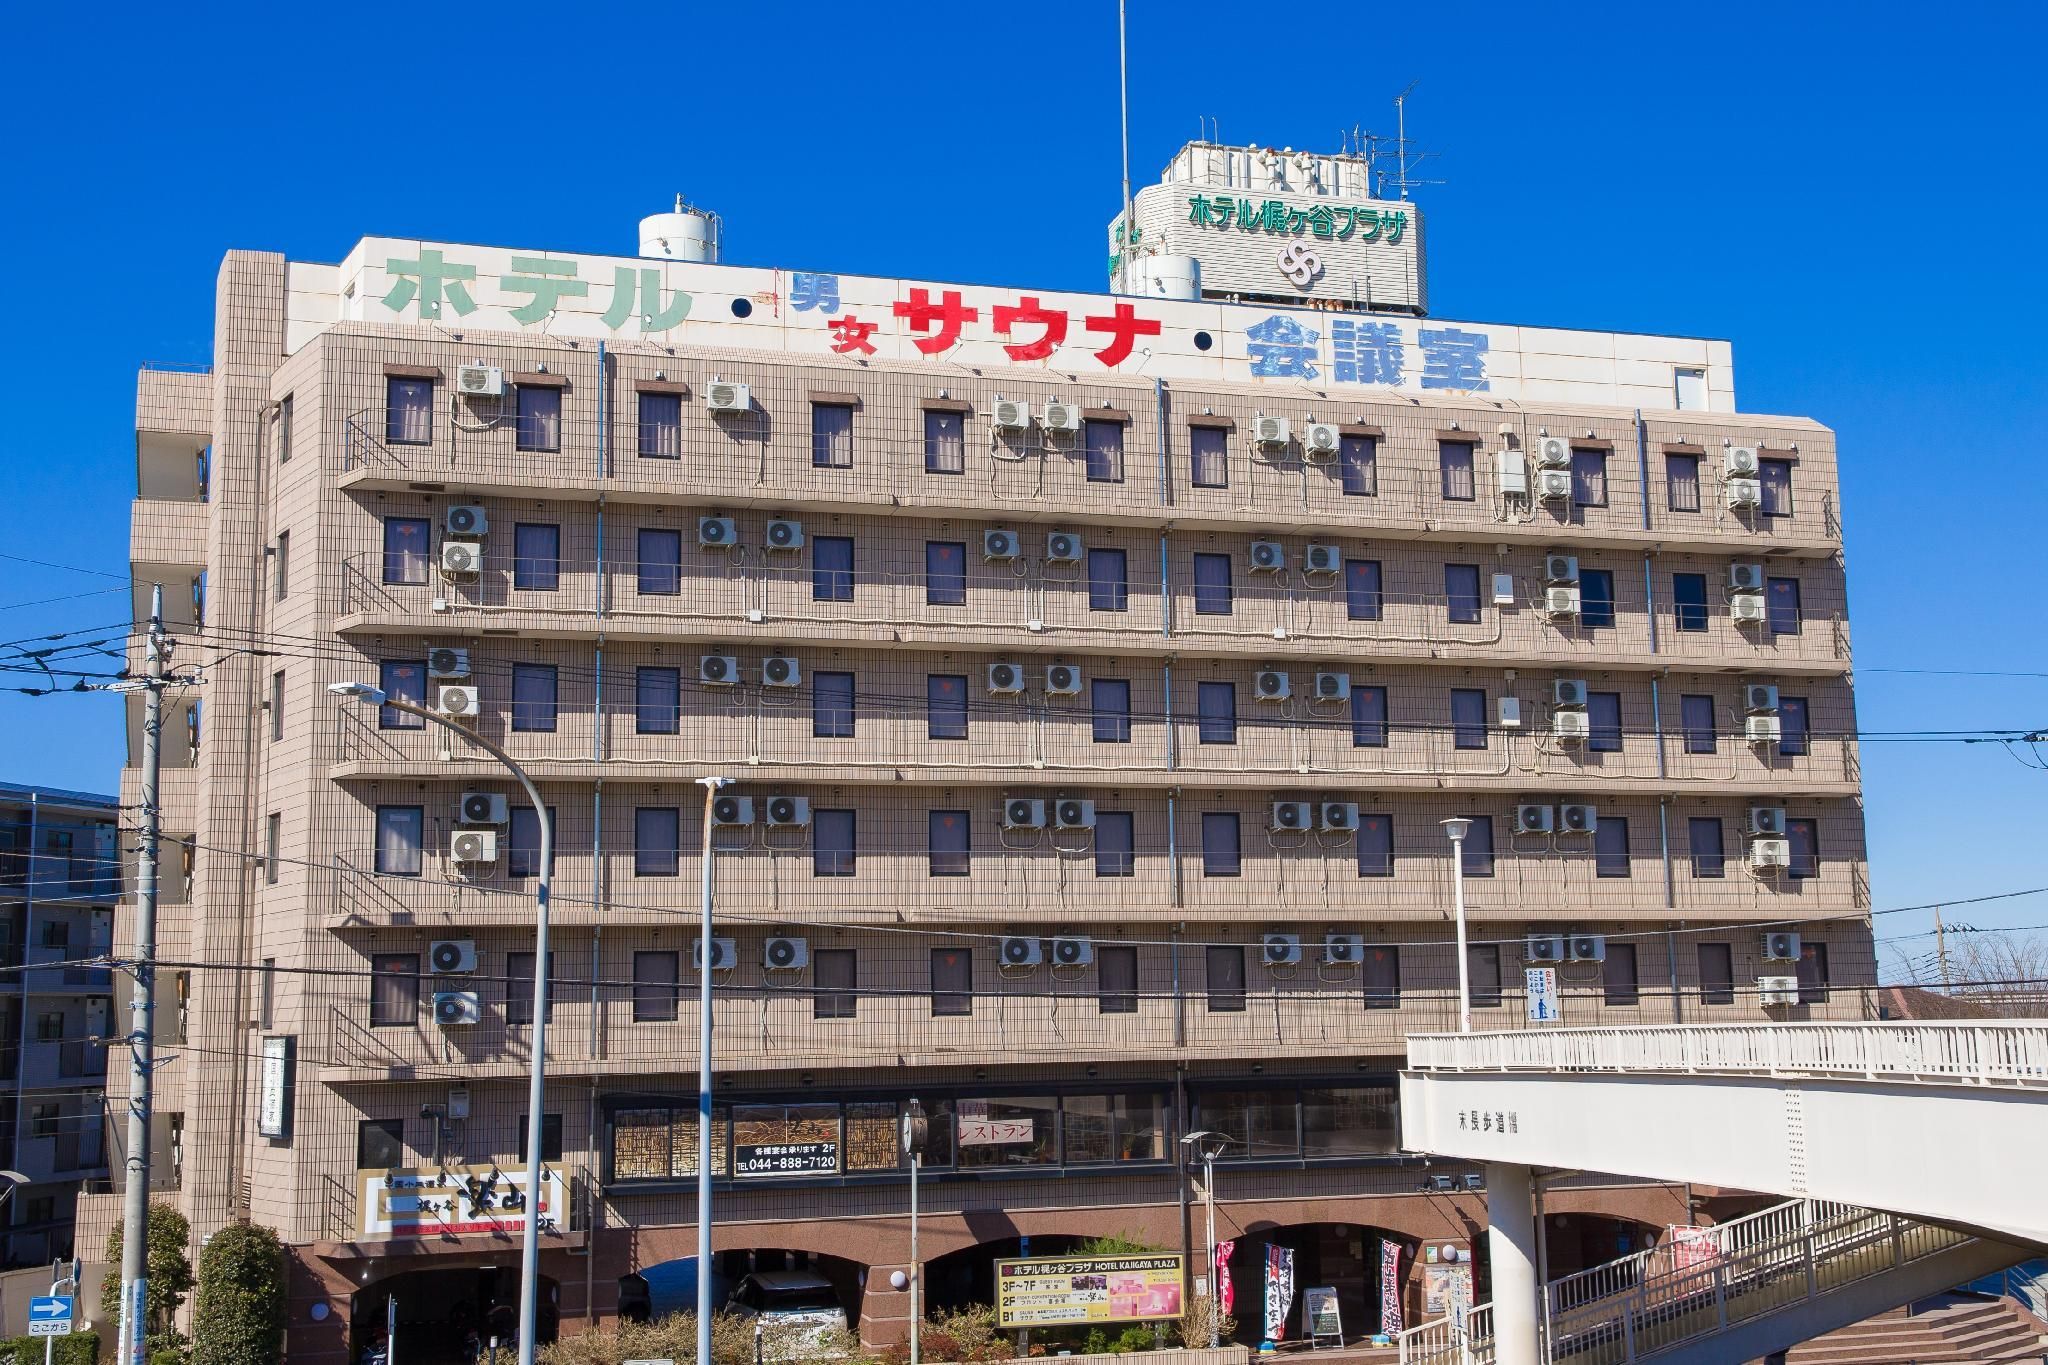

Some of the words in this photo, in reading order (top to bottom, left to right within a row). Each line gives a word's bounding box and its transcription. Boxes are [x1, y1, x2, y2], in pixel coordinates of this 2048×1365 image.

[382, 250, 693, 332] ホテル
[893, 287, 1162, 368] サウナ
[1245, 314, 1490, 392] 会議室
[959, 1124, 1032, 1141] レストラン
[822, 1144, 836, 1152] 2F
[737, 1162, 749, 1171] TEL
[749, 1156, 836, 1170] 044-888-7120
[1095, 1262, 1119, 1271] HOTEL
[1154, 1260, 1176, 1268] PLAZA
[1002, 1296, 1016, 1307] 2F
[1002, 1311, 1014, 1322] B1
[31, 1323, 69, 1333] ここから
